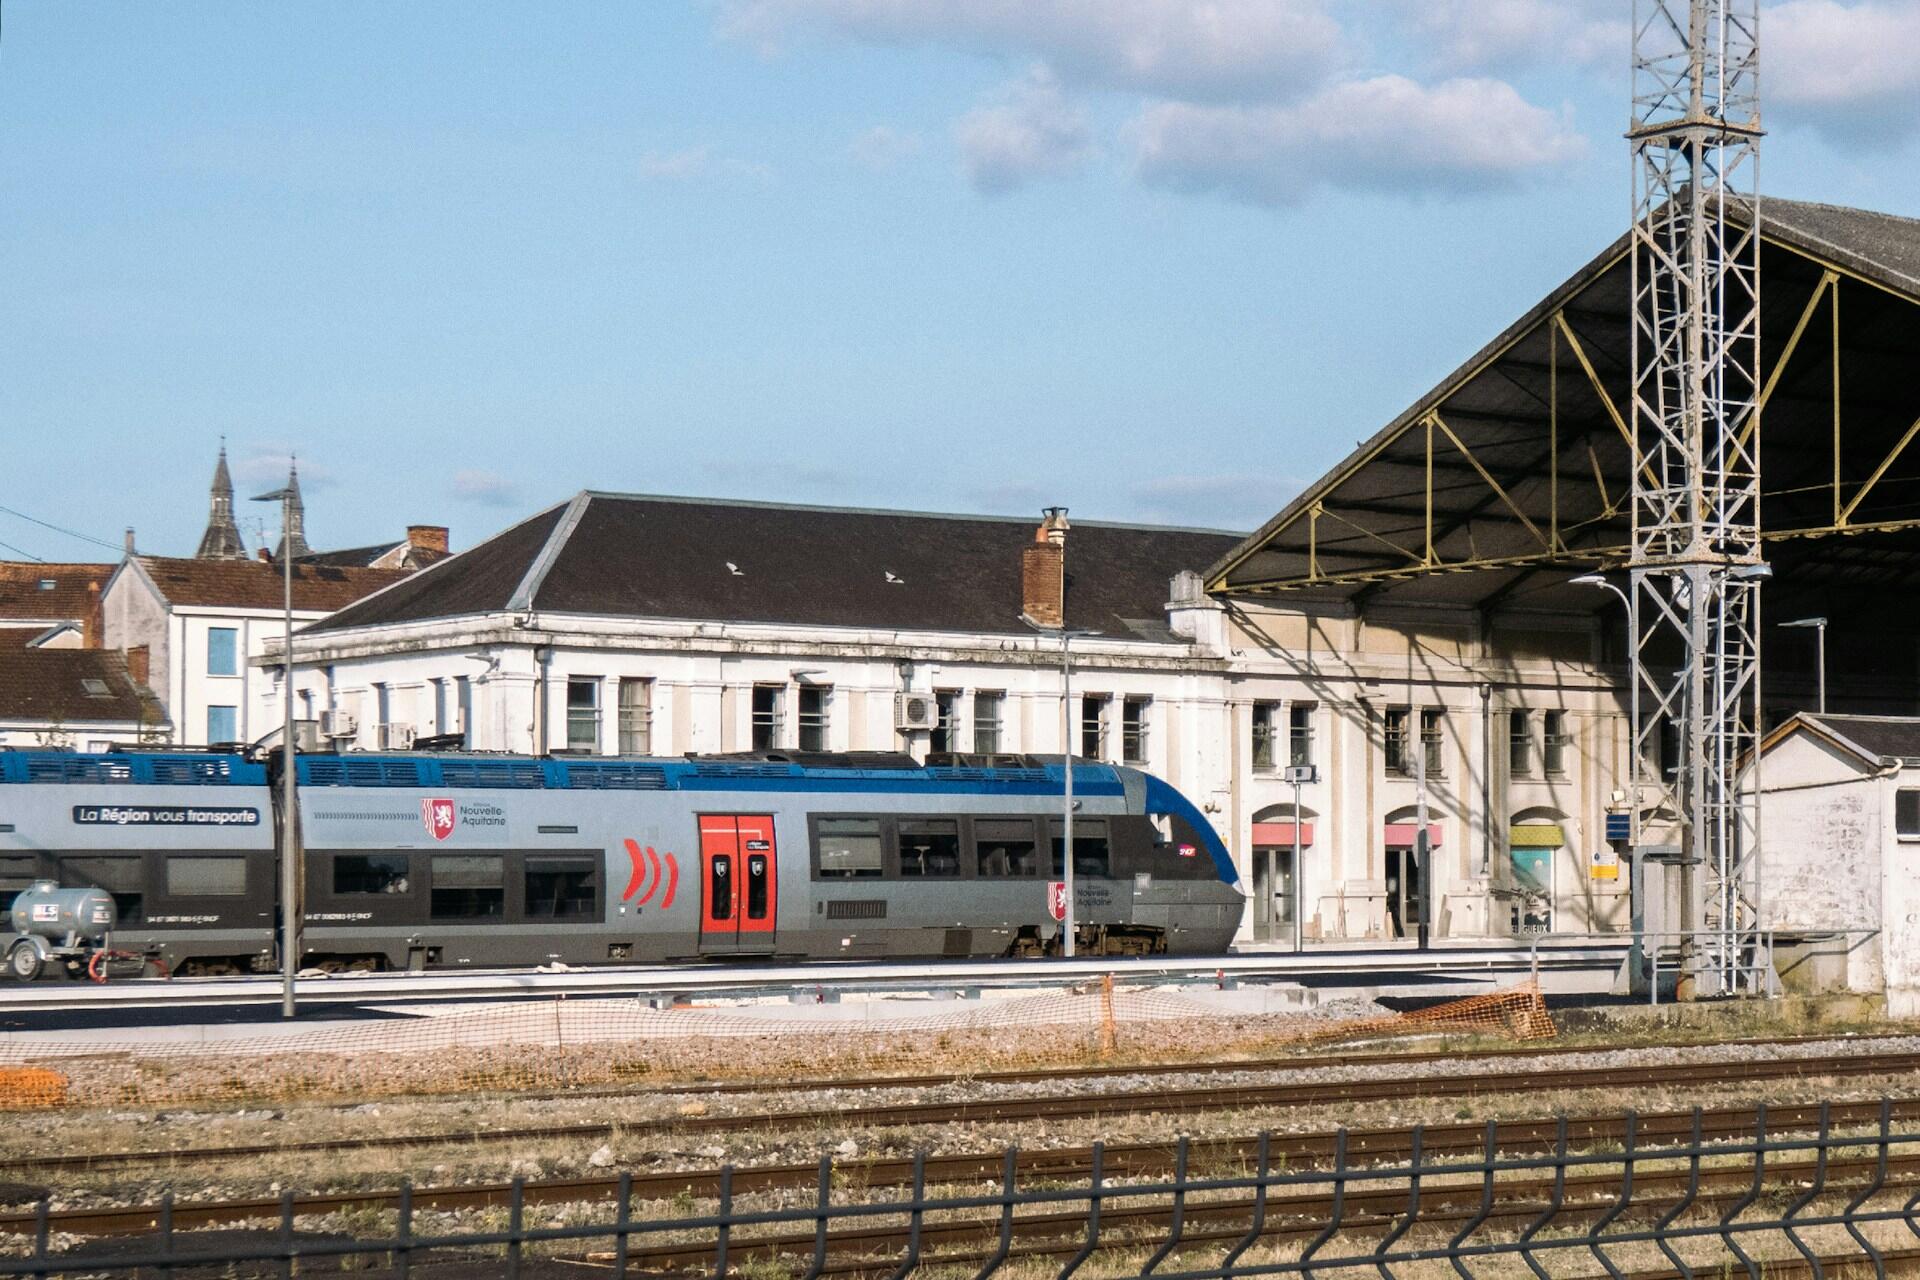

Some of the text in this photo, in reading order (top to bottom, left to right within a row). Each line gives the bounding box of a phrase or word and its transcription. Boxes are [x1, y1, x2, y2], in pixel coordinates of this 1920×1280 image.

[79, 808, 256, 824] La Région vous transporte
[460, 806, 505, 816] Nouvelle-
[462, 816, 506, 828] Aquitaine
